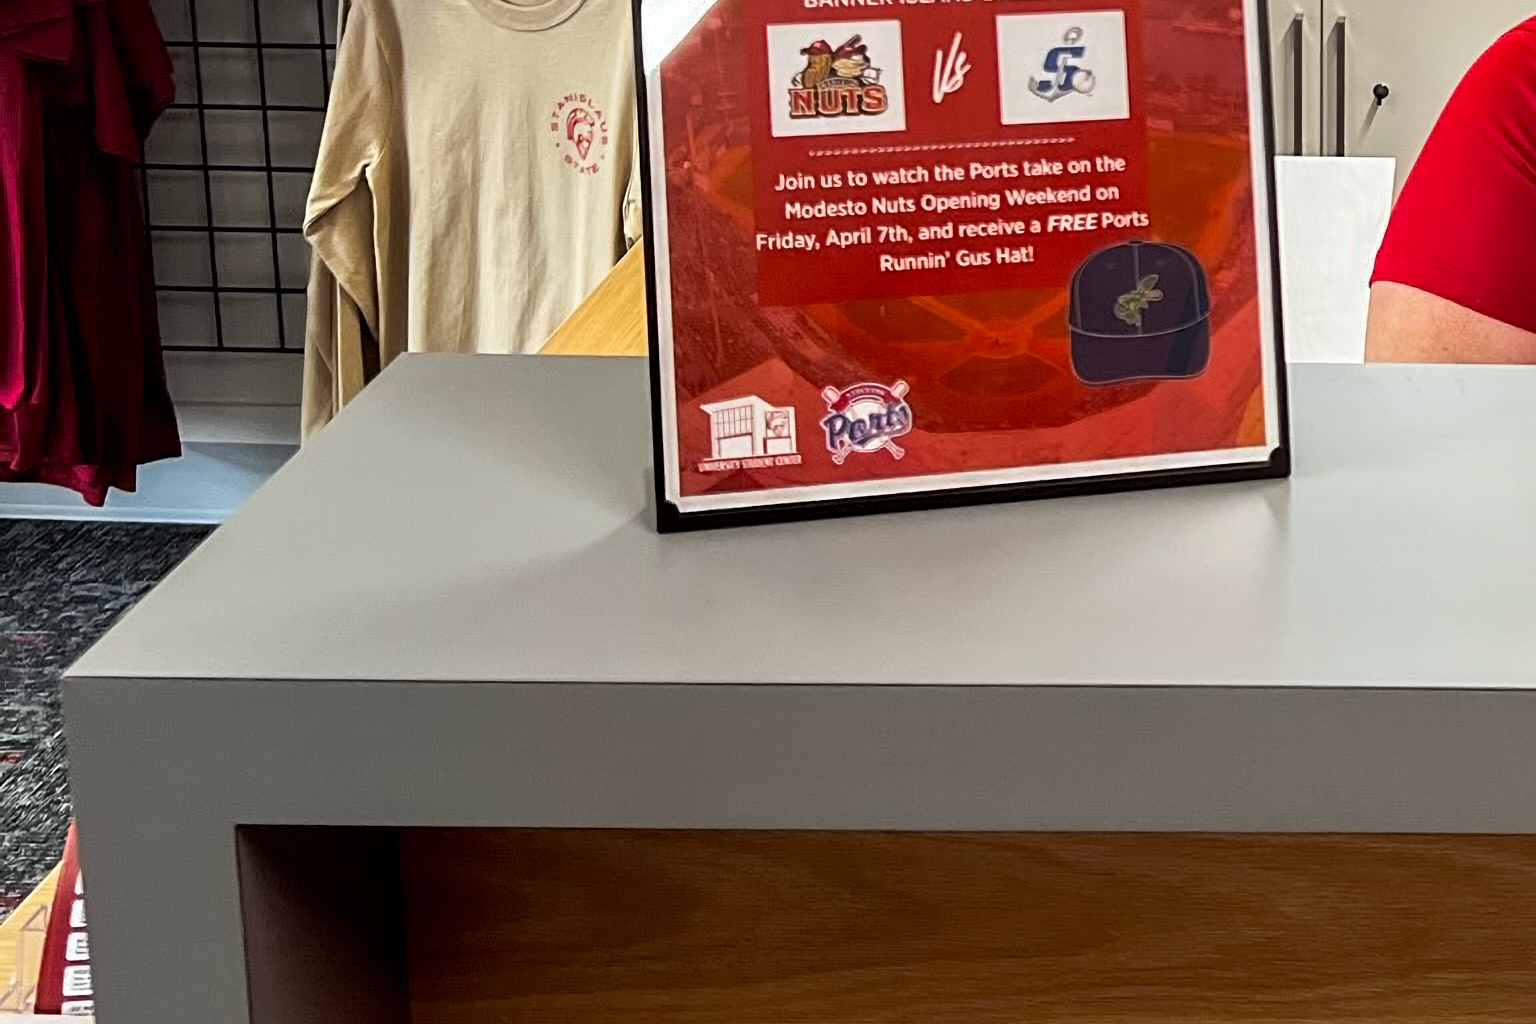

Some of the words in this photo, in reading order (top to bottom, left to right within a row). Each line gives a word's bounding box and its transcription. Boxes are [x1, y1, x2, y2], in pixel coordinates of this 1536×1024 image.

[789, 86, 889, 118] NUTS
[774, 172, 816, 191] Join
[820, 174, 843, 188] us
[847, 170, 868, 186] to
[872, 166, 929, 185] watch
[934, 164, 965, 182] the
[969, 161, 1019, 180] Ports
[1023, 158, 1064, 176] take
[1067, 160, 1092, 174] on
[1095, 154, 1127, 172] the
[784, 200, 868, 220] Modesto
[872, 196, 917, 214] Nuts
[920, 191, 1001, 213] Opening
[1004, 184, 1091, 206] Weekend
[1095, 186, 1120, 201] on
[755, 229, 821, 251] Friday,
[825, 226, 872, 249] April
[877, 224, 914, 244] 7th,
[917, 221, 954, 240] and
[958, 218, 1026, 237] receive
[1029, 220, 1041, 233] a
[1047, 213, 1099, 232] FREE
[1101, 210, 1150, 228] Ports
[955, 250, 992, 266] Gus
[995, 245, 1034, 265] Hat!
